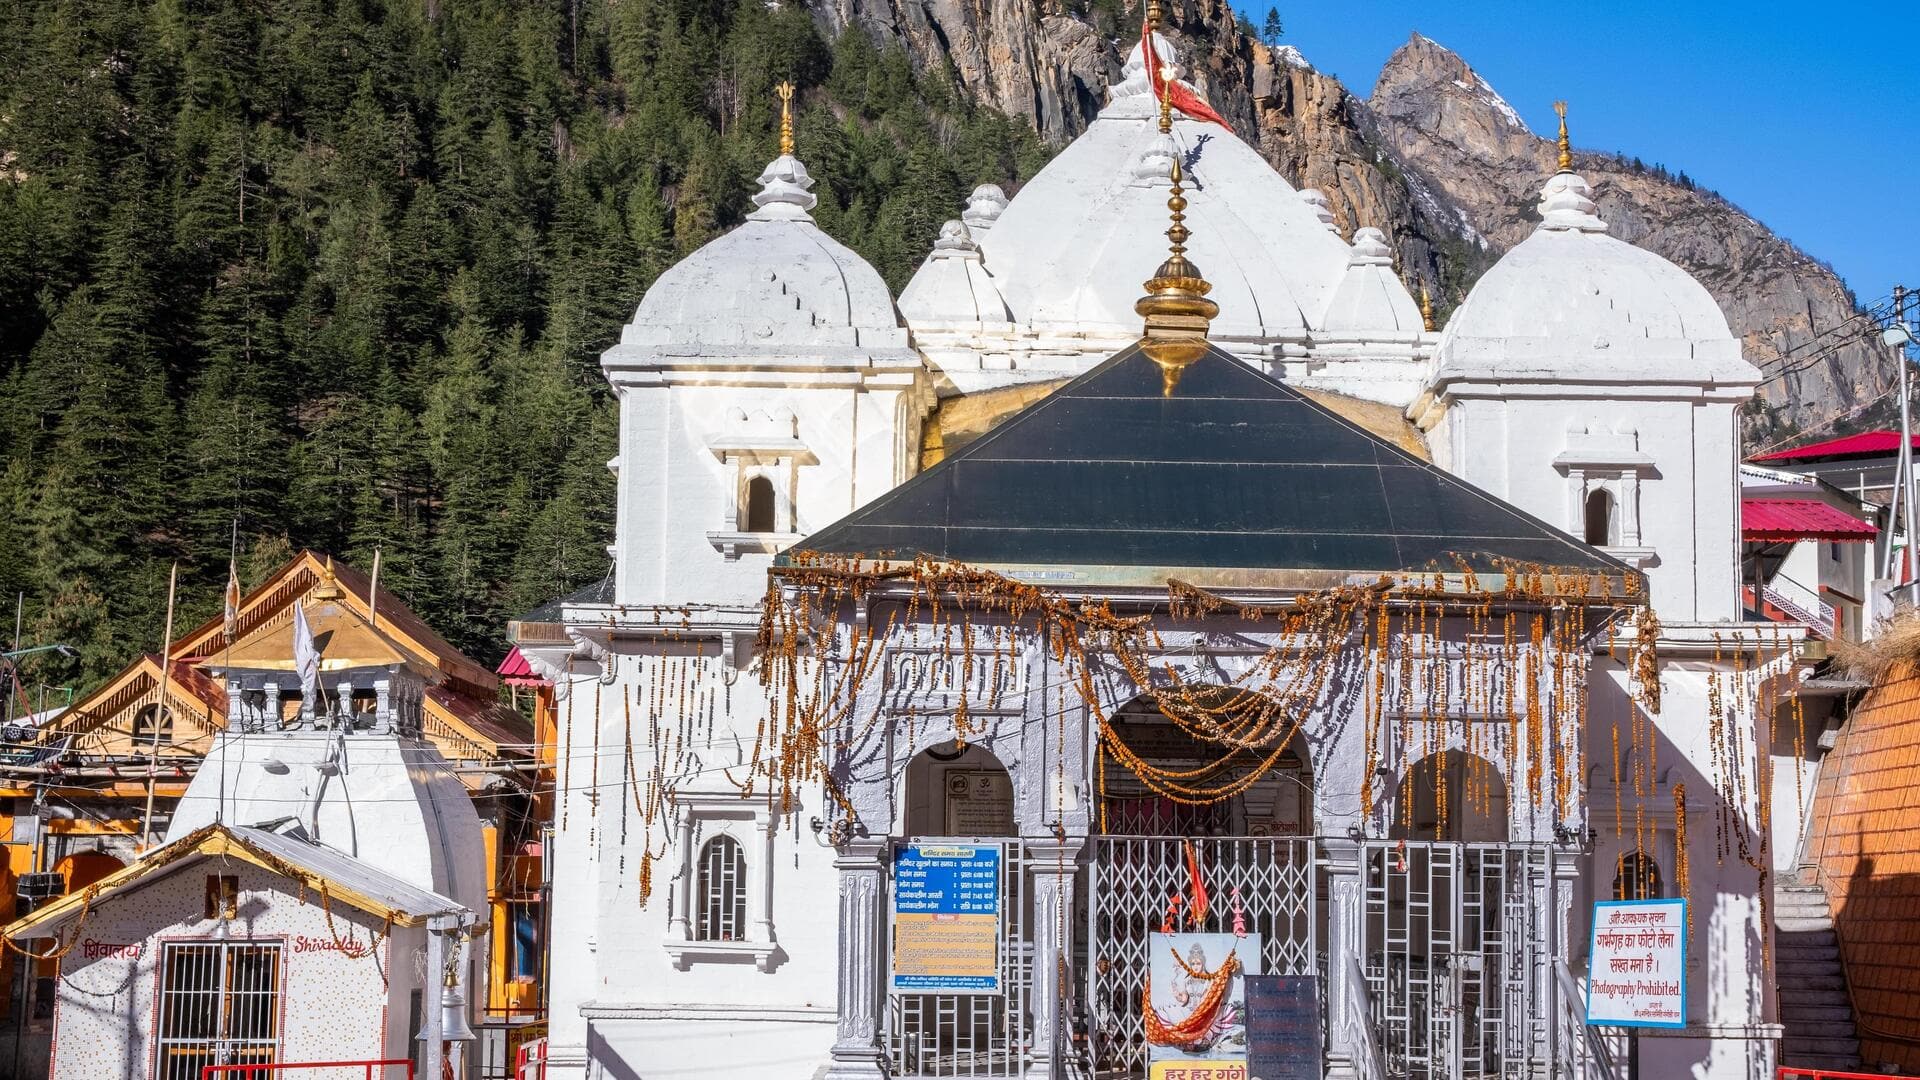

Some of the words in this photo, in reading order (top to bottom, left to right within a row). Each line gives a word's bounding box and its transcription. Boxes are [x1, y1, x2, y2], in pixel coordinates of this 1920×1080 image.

[1608, 910, 1621, 925] अति
[81, 938, 141, 961] शिवालय
[1597, 929, 1624, 954] गर्भगृह
[1625, 933, 1636, 949] का
[1657, 928, 1675, 949] लेना
[1629, 958, 1644, 974] मना
[1645, 952, 1654, 974] है
[1590, 979, 1637, 999] Photography
[1637, 979, 1682, 996] Prohibited.
[1165, 1069, 1188, 1080] हर
[1190, 1069, 1213, 1080] हर
[1216, 1064, 1247, 1080] गंगे
